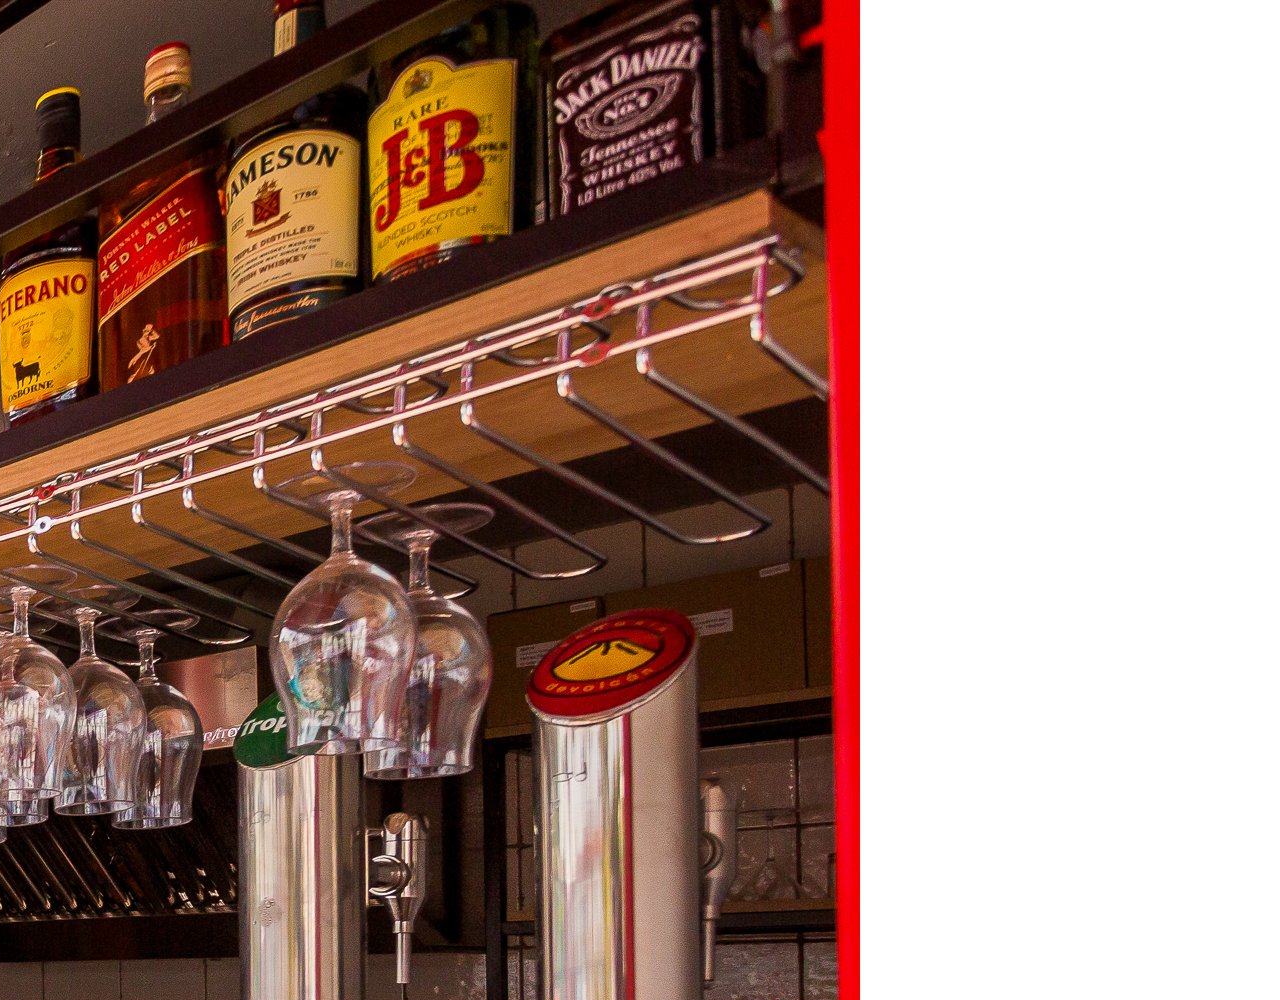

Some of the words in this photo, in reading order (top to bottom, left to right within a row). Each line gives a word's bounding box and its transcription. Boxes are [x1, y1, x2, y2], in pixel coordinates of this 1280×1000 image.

[393, 96, 449, 130] RARE
[554, 69, 612, 124] JACK
[580, 118, 679, 168] Tennessee
[583, 139, 678, 187] WHISKEY
[374, 108, 485, 232] J&B
[103, 228, 140, 265] JOHNNIE
[141, 196, 183, 229] WALKER
[260, 224, 315, 248] DISTILLED
[420, 205, 478, 228] SCOTCH
[100, 251, 130, 282] RED
[134, 207, 192, 252] LABEL
[259, 252, 308, 275] WHISKEY
[0, 274, 88, 324] ETERANO
[8, 379, 54, 403] OSBORNE
